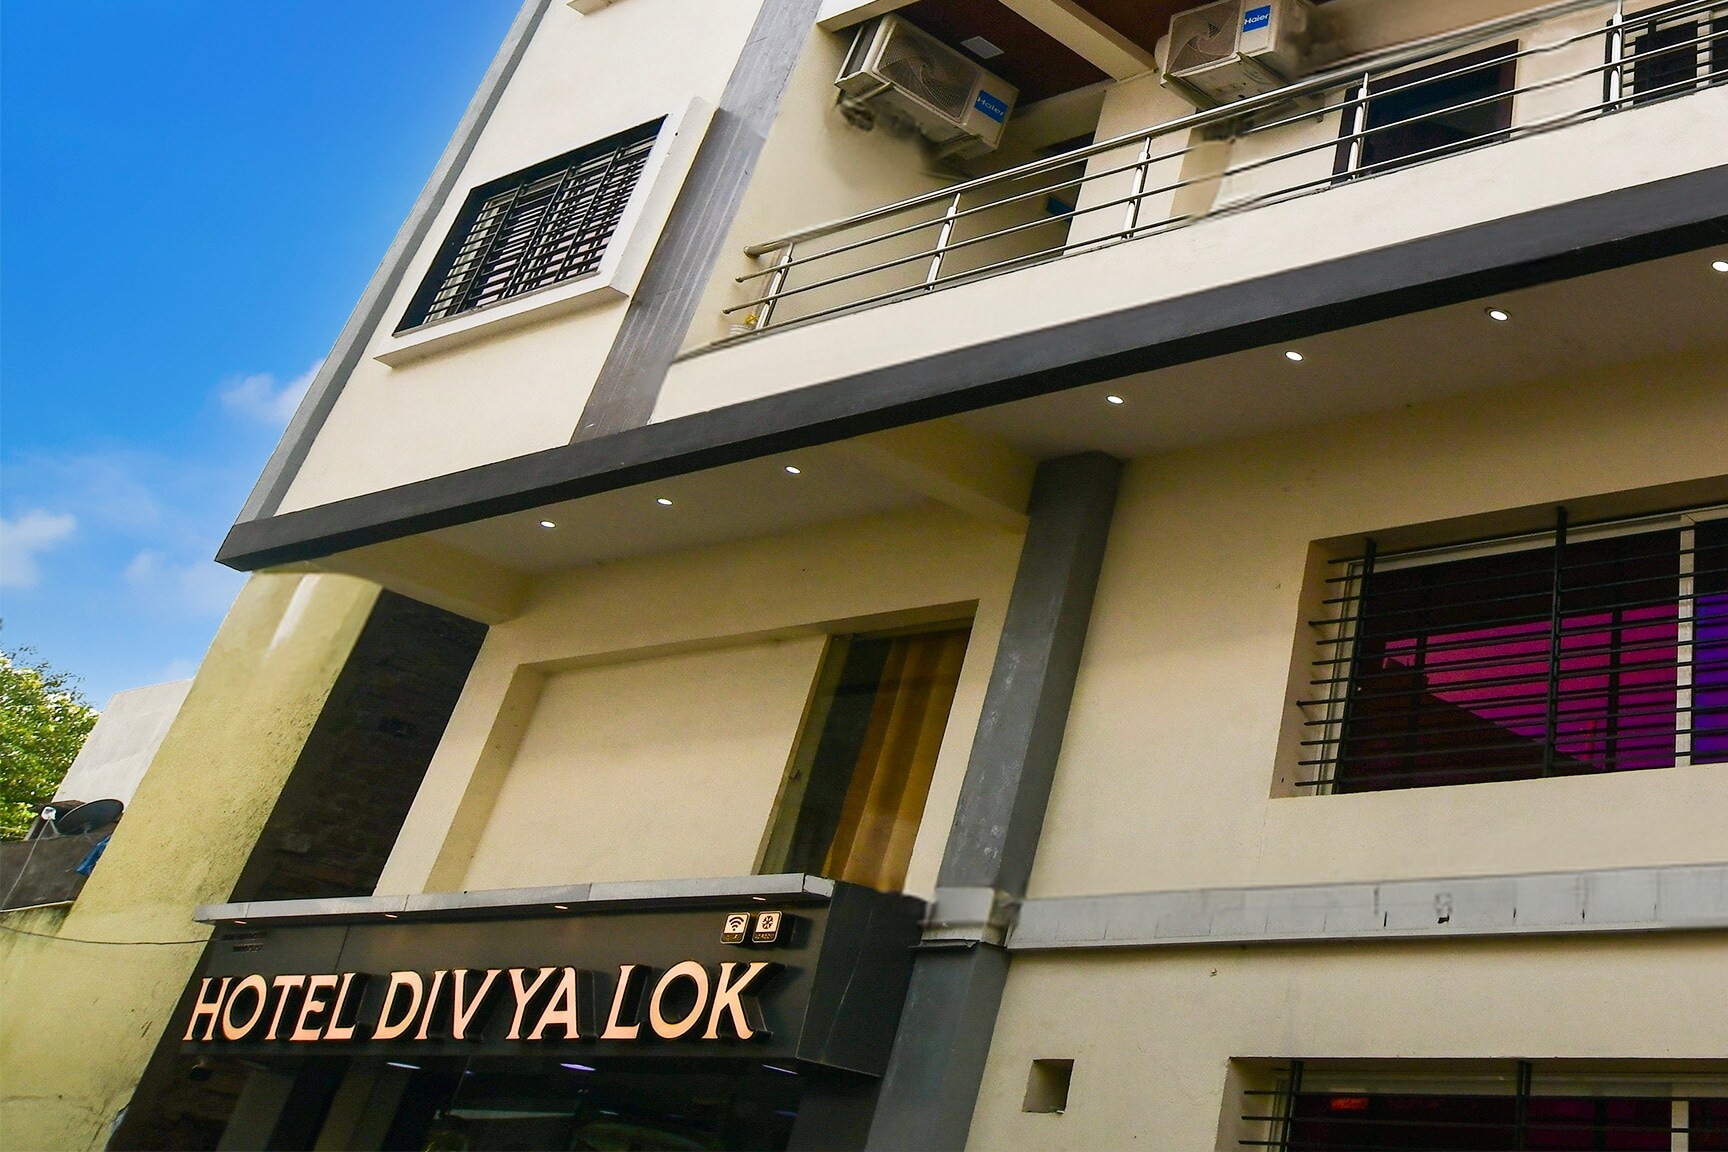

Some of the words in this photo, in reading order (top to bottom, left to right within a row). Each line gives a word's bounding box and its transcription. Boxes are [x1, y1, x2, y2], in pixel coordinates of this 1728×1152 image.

[1244, 13, 1269, 25] Haier
[976, 96, 1005, 117] Haier
[182, 971, 357, 1041] HOTEL
[600, 960, 771, 1040] LOK
